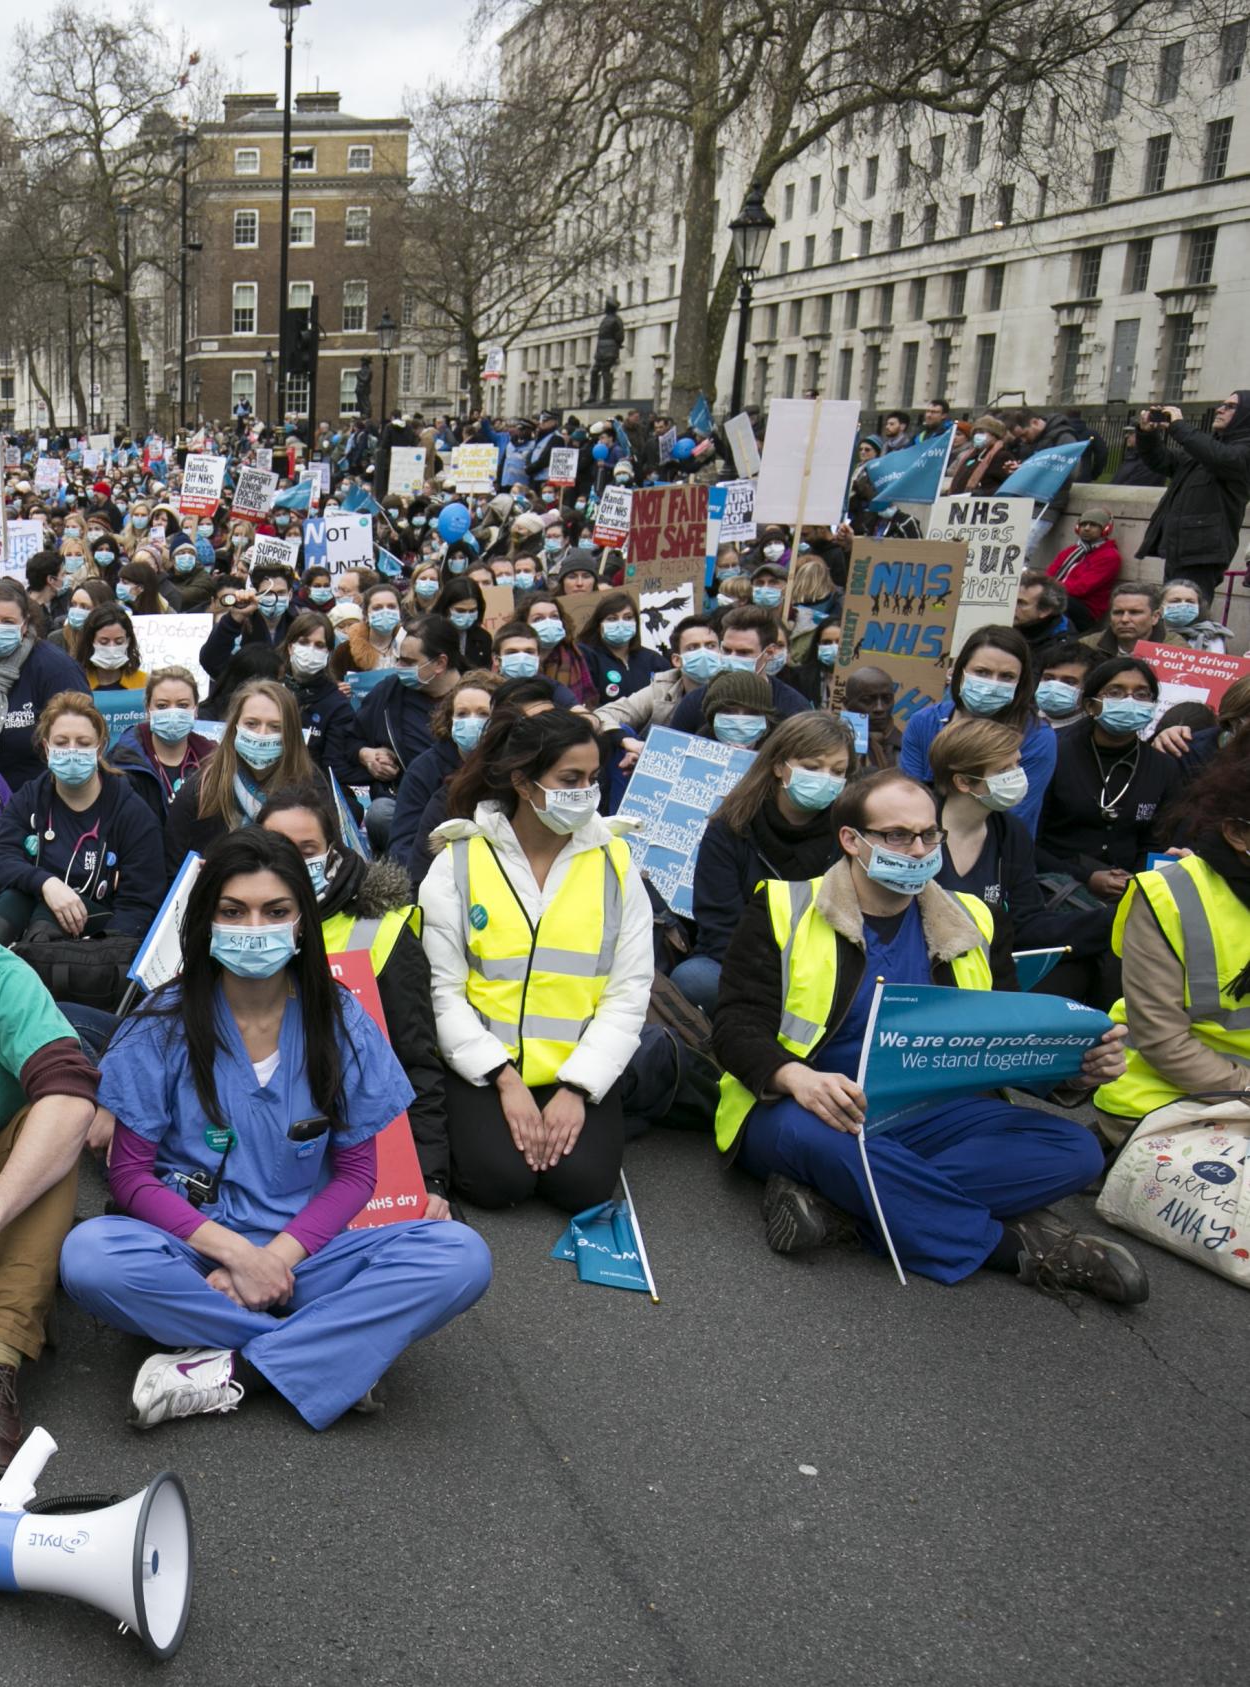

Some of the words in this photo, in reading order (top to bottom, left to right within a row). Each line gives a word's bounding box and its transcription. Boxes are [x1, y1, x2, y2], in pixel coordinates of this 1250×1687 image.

[188, 462, 208, 472] Hands
[186, 472, 196, 482] Off
[198, 473, 214, 484] NHS
[240, 482, 263, 491] JUNIOR
[242, 472, 272, 485] SUPPORT
[184, 483, 218, 496] Bursaries
[235, 497, 262, 509] STRIKES
[604, 494, 624, 506] Hands
[632, 489, 665, 527] NOT
[669, 486, 708, 524] FAIR
[601, 504, 613, 514] Off
[615, 506, 627, 517] NHS
[948, 501, 1009, 525] NHS
[598, 516, 629, 528] Bursaries
[305, 522, 350, 544] NOT
[930, 526, 1014, 543] DOCTORS
[257, 542, 292, 562] SUPPORT
[628, 526, 662, 563] NOT
[661, 524, 706, 559] SAFE
[660, 560, 700, 574] PATIENTS
[980, 544, 1020, 575] UR
[644, 578, 662, 590] NHS
[869, 561, 952, 597] NHS
[147, 620, 209, 638] Doctors
[862, 621, 946, 658] NHS
[1154, 647, 1195, 662] You've
[1199, 656, 1239, 670] driven
[1164, 661, 1184, 670] out
[688, 745, 729, 764] SINGERS
[691, 737, 732, 756] HEALTH
[642, 757, 680, 772] HEALTH
[646, 751, 684, 766] NATIONAL
[639, 764, 678, 781] SINGERS
[674, 784, 714, 799] HEALTH
[678, 776, 717, 793] NATIONAL
[553, 791, 579, 802] TIME
[626, 792, 664, 807] NATIONAL
[670, 790, 711, 808] SINGERS
[619, 806, 658, 822] NATIONAL
[655, 827, 695, 844] HEALTH
[659, 821, 697, 838] NATIONAL
[652, 834, 691, 852] SINGERS
[642, 863, 680, 880] NATIONAL
[1066, 1002, 1096, 1012] BMA
[878, 1032, 908, 1047] We
[912, 1036, 944, 1047] are
[949, 1035, 984, 1047] one
[987, 1034, 1095, 1050] profession
[901, 1053, 927, 1069] We
[932, 1051, 978, 1067] stand
[984, 1050, 1058, 1070] together
[366, 1195, 393, 1211] NHS
[397, 1194, 418, 1207] dry
[1157, 1197, 1231, 1250] AWAY
[28, 1532, 63, 1548] PYLE
